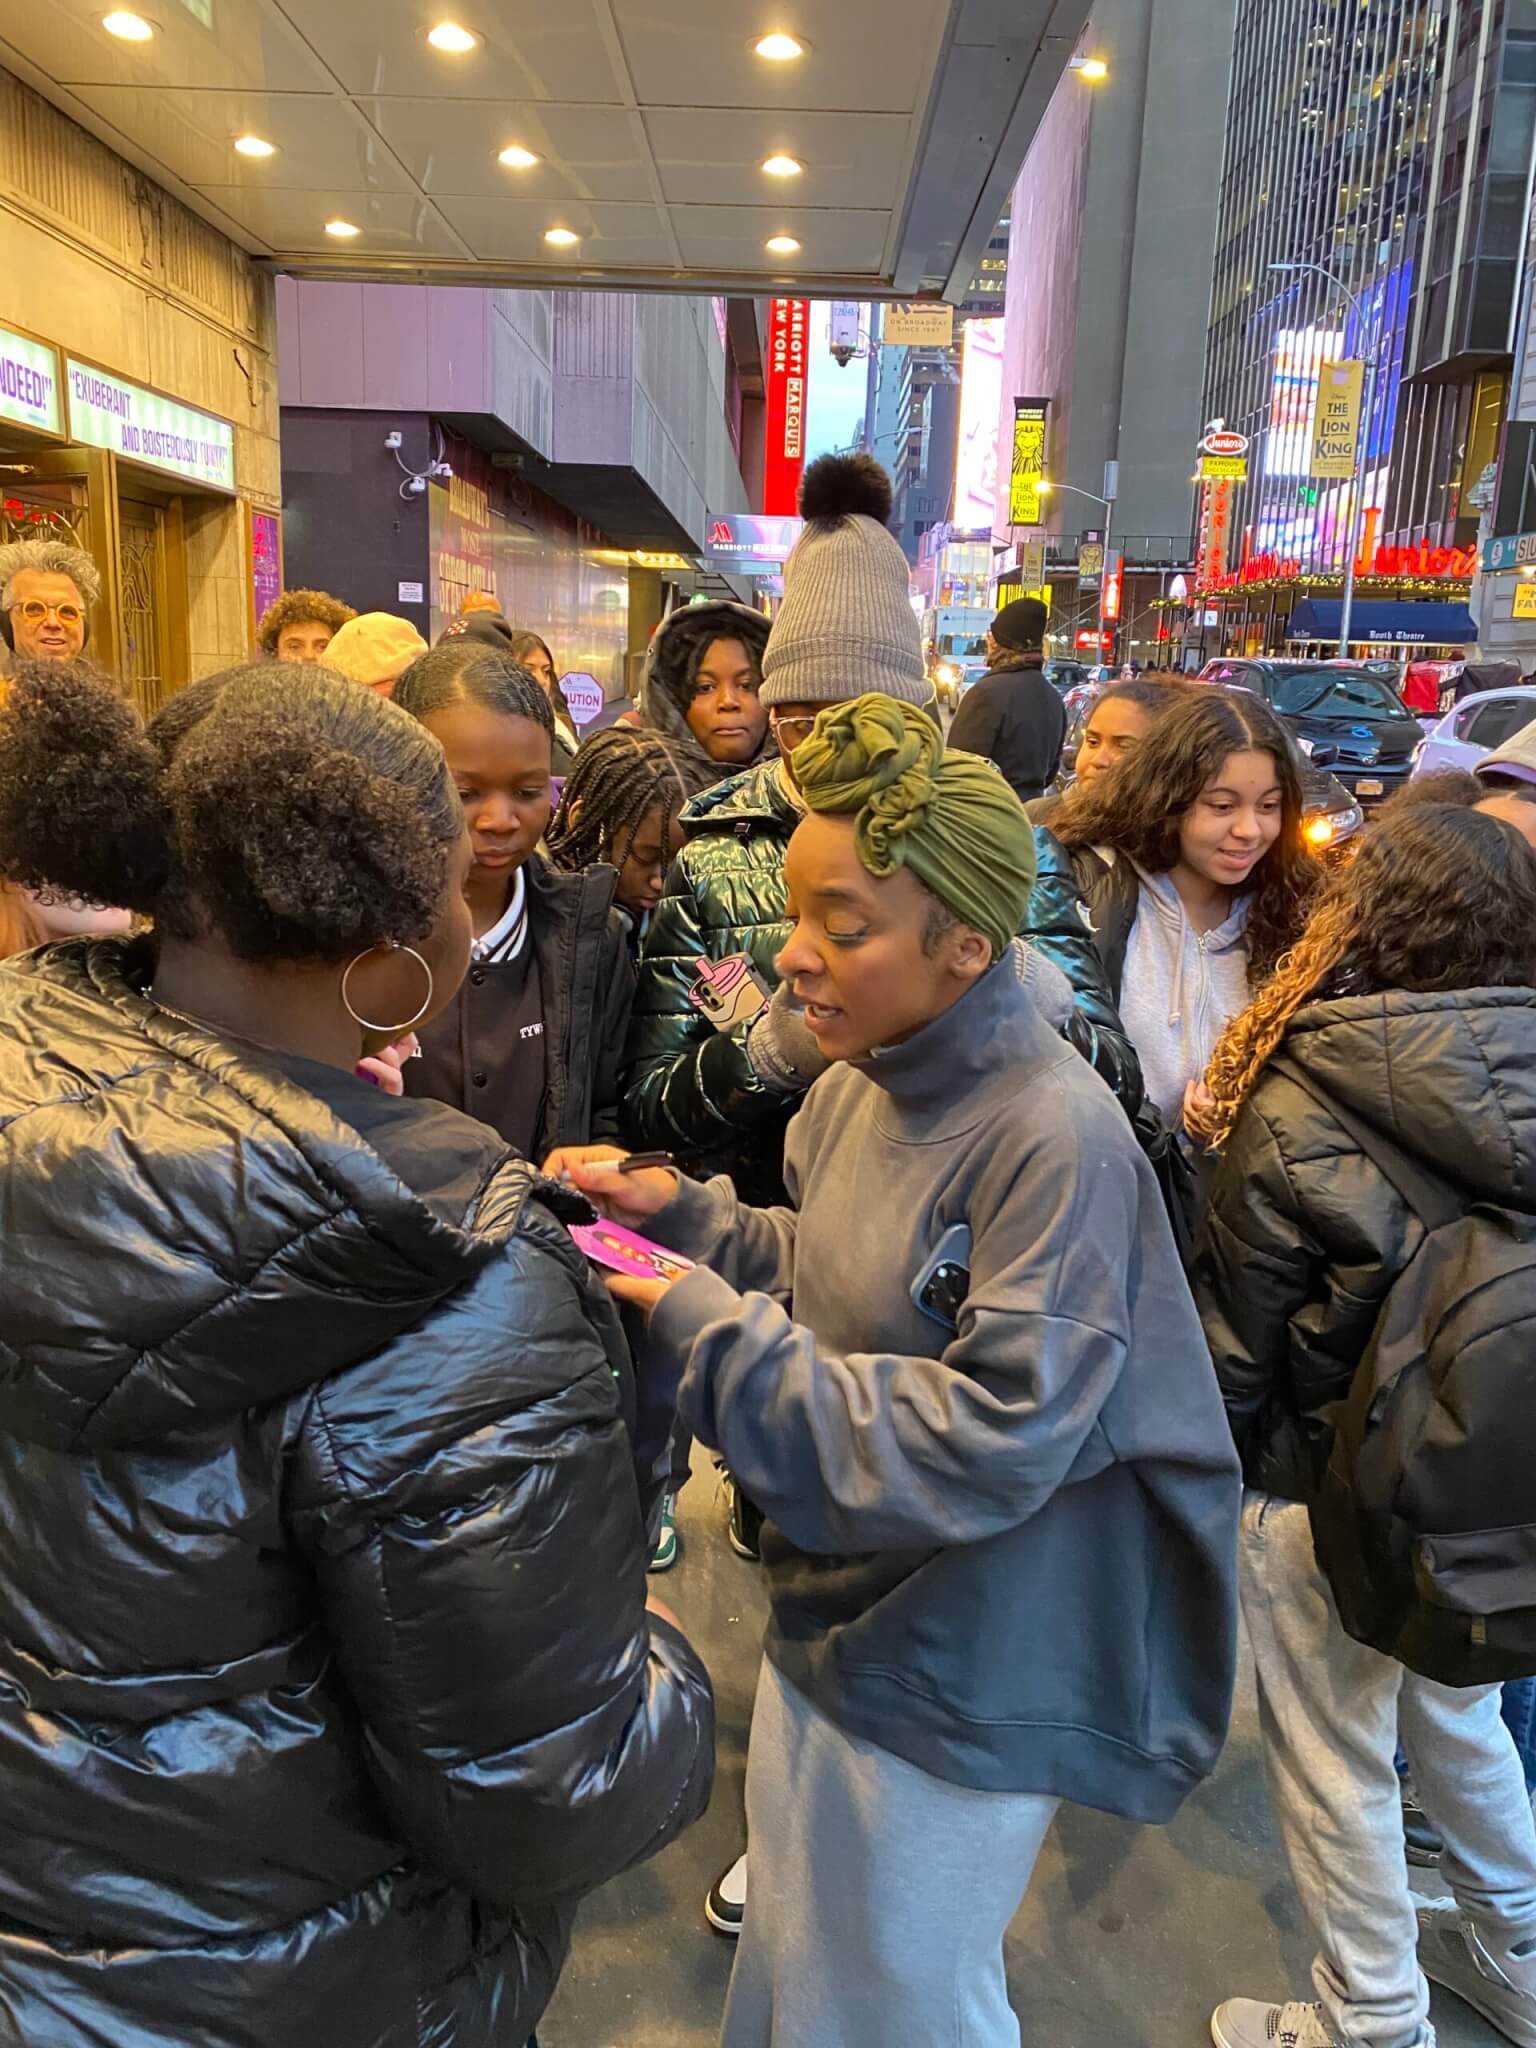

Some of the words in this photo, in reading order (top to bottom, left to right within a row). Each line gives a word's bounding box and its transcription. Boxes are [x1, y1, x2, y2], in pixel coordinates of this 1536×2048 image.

[776, 298, 787, 323] EW
[774, 328, 787, 373] YORK
[1327, 402, 1348, 414] THE
[786, 379, 801, 457] MARQUIS
[1320, 418, 1350, 437] LION
[121, 423, 140, 453] AND
[142, 429, 198, 464] BOISTEROUSLY
[1315, 439, 1353, 459] KING
[713, 543, 752, 552] MARRIOTT
[1395, 630, 1425, 641] Theatre
[568, 693, 600, 706] UTION
